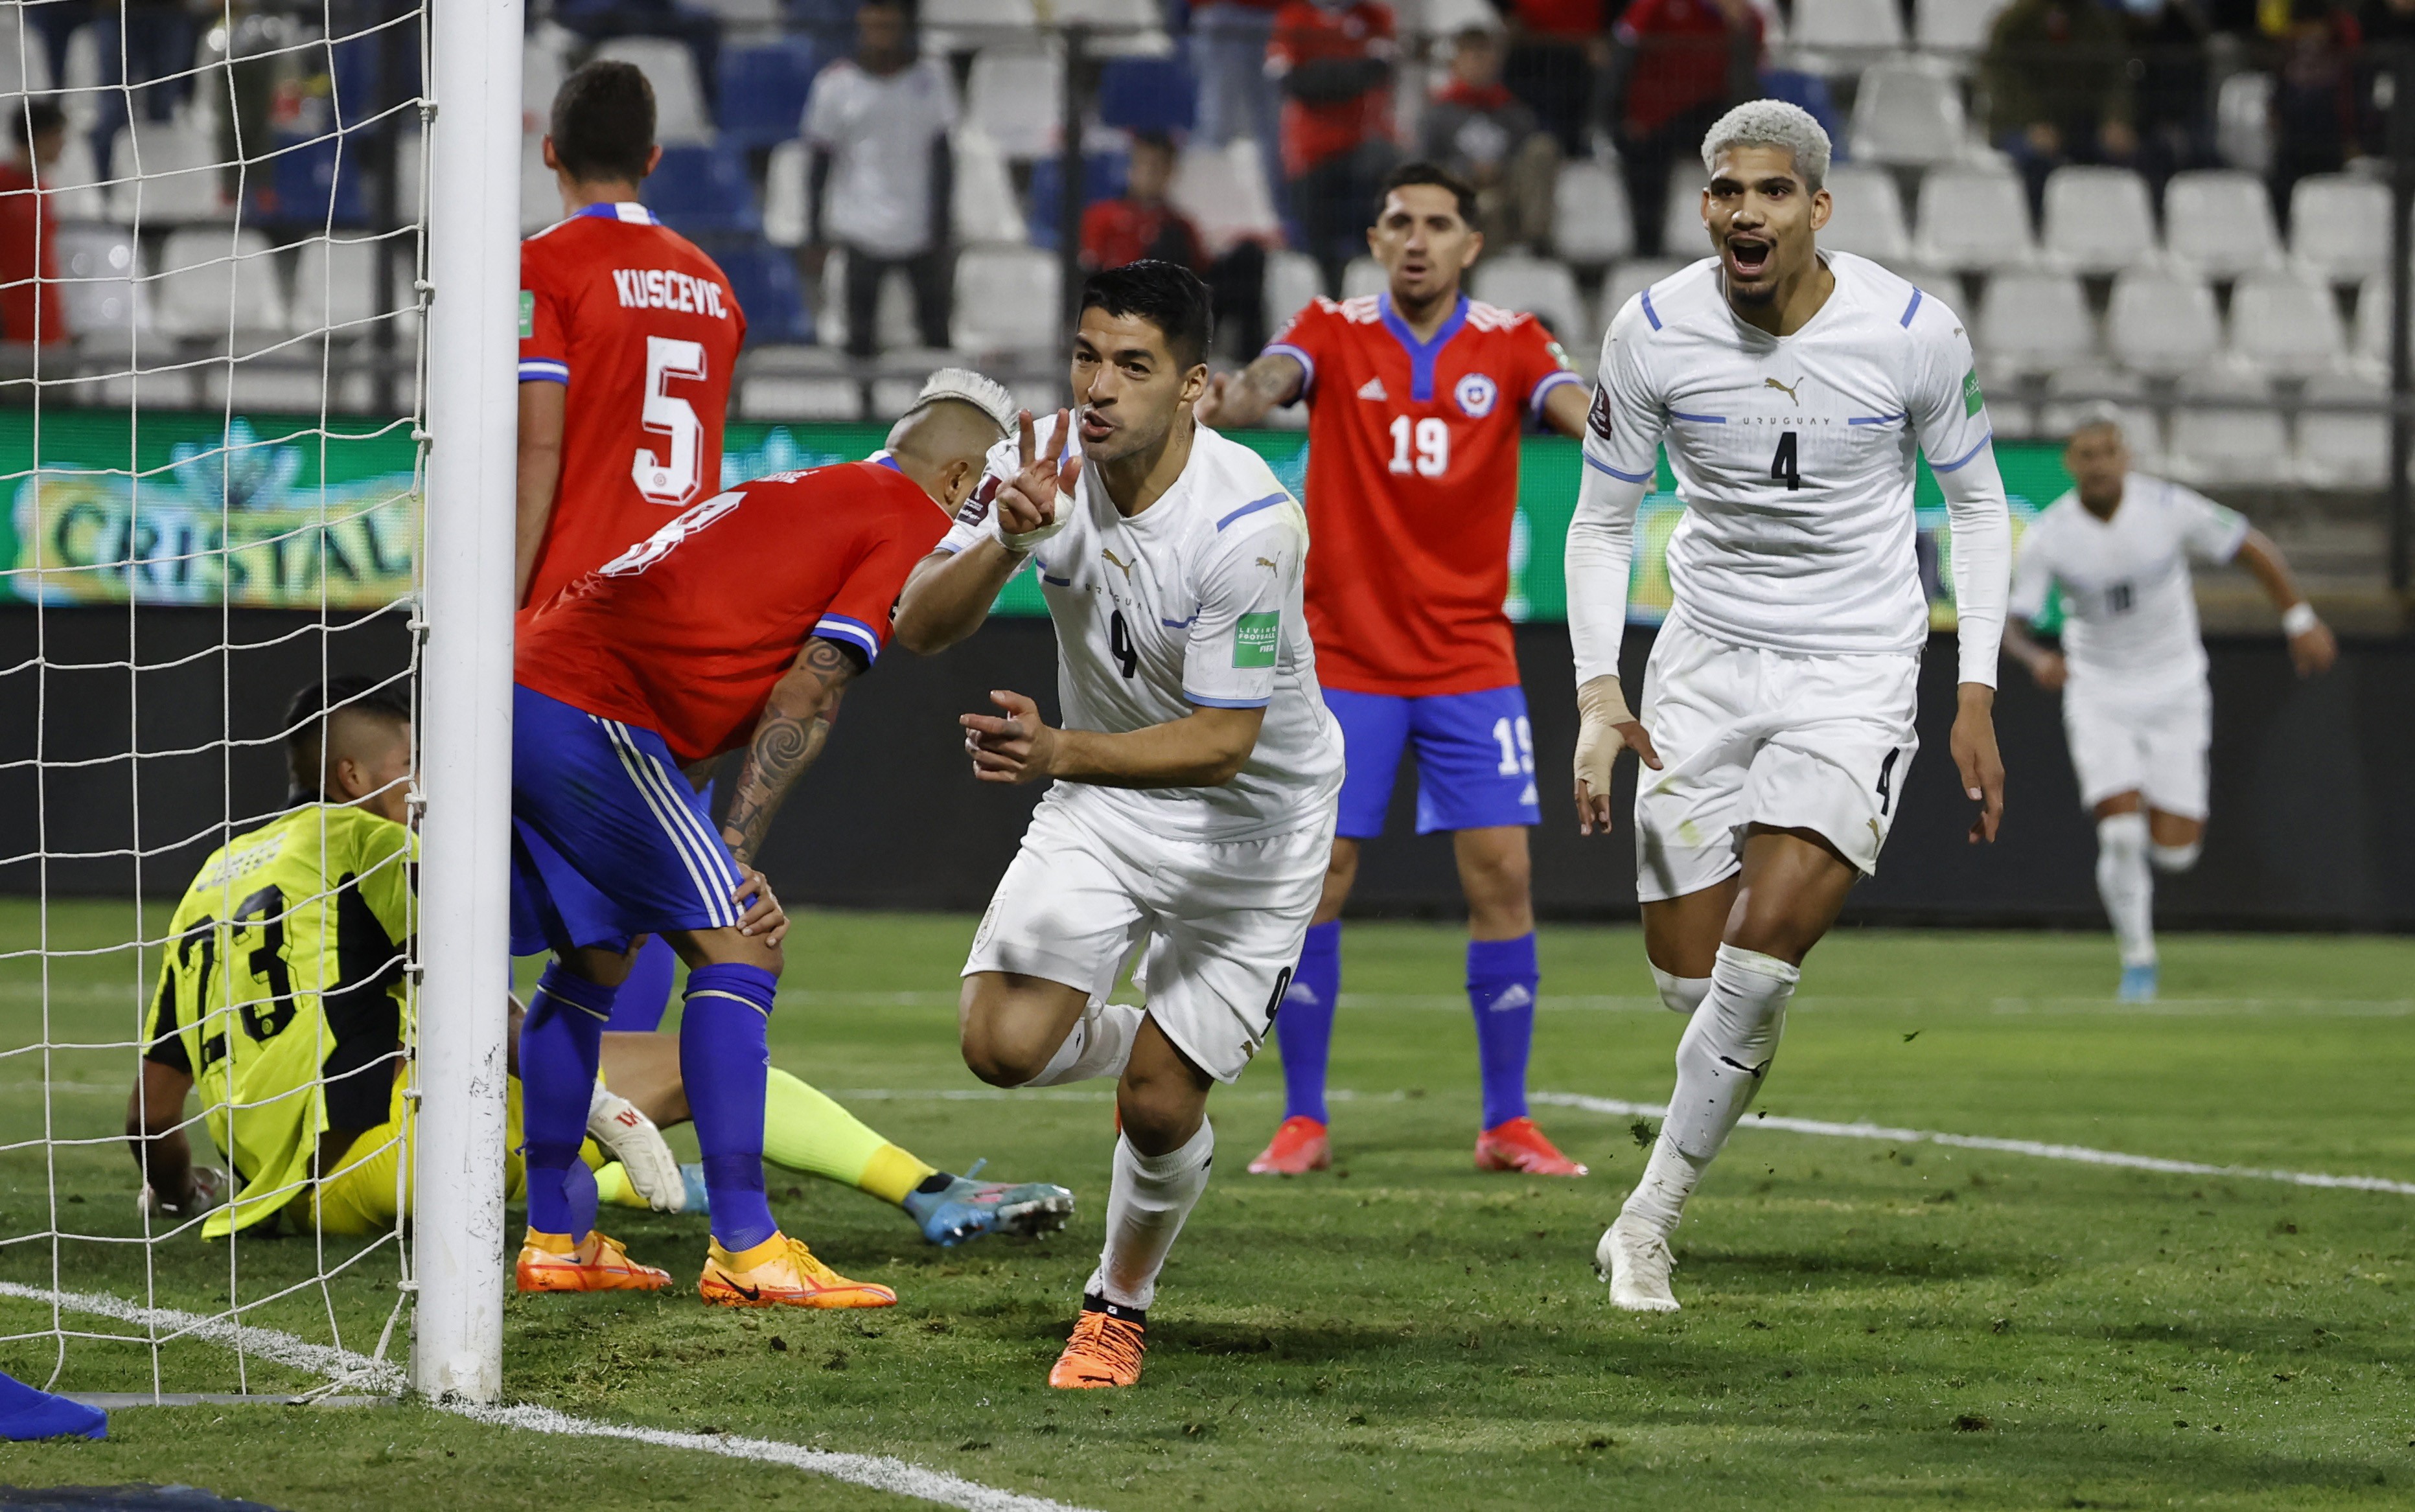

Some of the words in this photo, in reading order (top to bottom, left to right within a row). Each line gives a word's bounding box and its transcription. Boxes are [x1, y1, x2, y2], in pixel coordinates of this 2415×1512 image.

[612, 269, 727, 319] KUSCEVIC
[630, 335, 708, 507] 5
[1388, 413, 1449, 477] 19
[1743, 417, 1830, 425] URUGUAY
[1771, 431, 1801, 490] 4
[54, 501, 413, 588] CRISTAL
[1111, 609, 1138, 679] 9
[1238, 632, 1275, 641] FOOTBALL
[1239, 625, 1277, 634] LIVING
[1259, 645, 1275, 654] FIFA
[1876, 746, 1901, 817] 4
[177, 883, 306, 1083] 23
